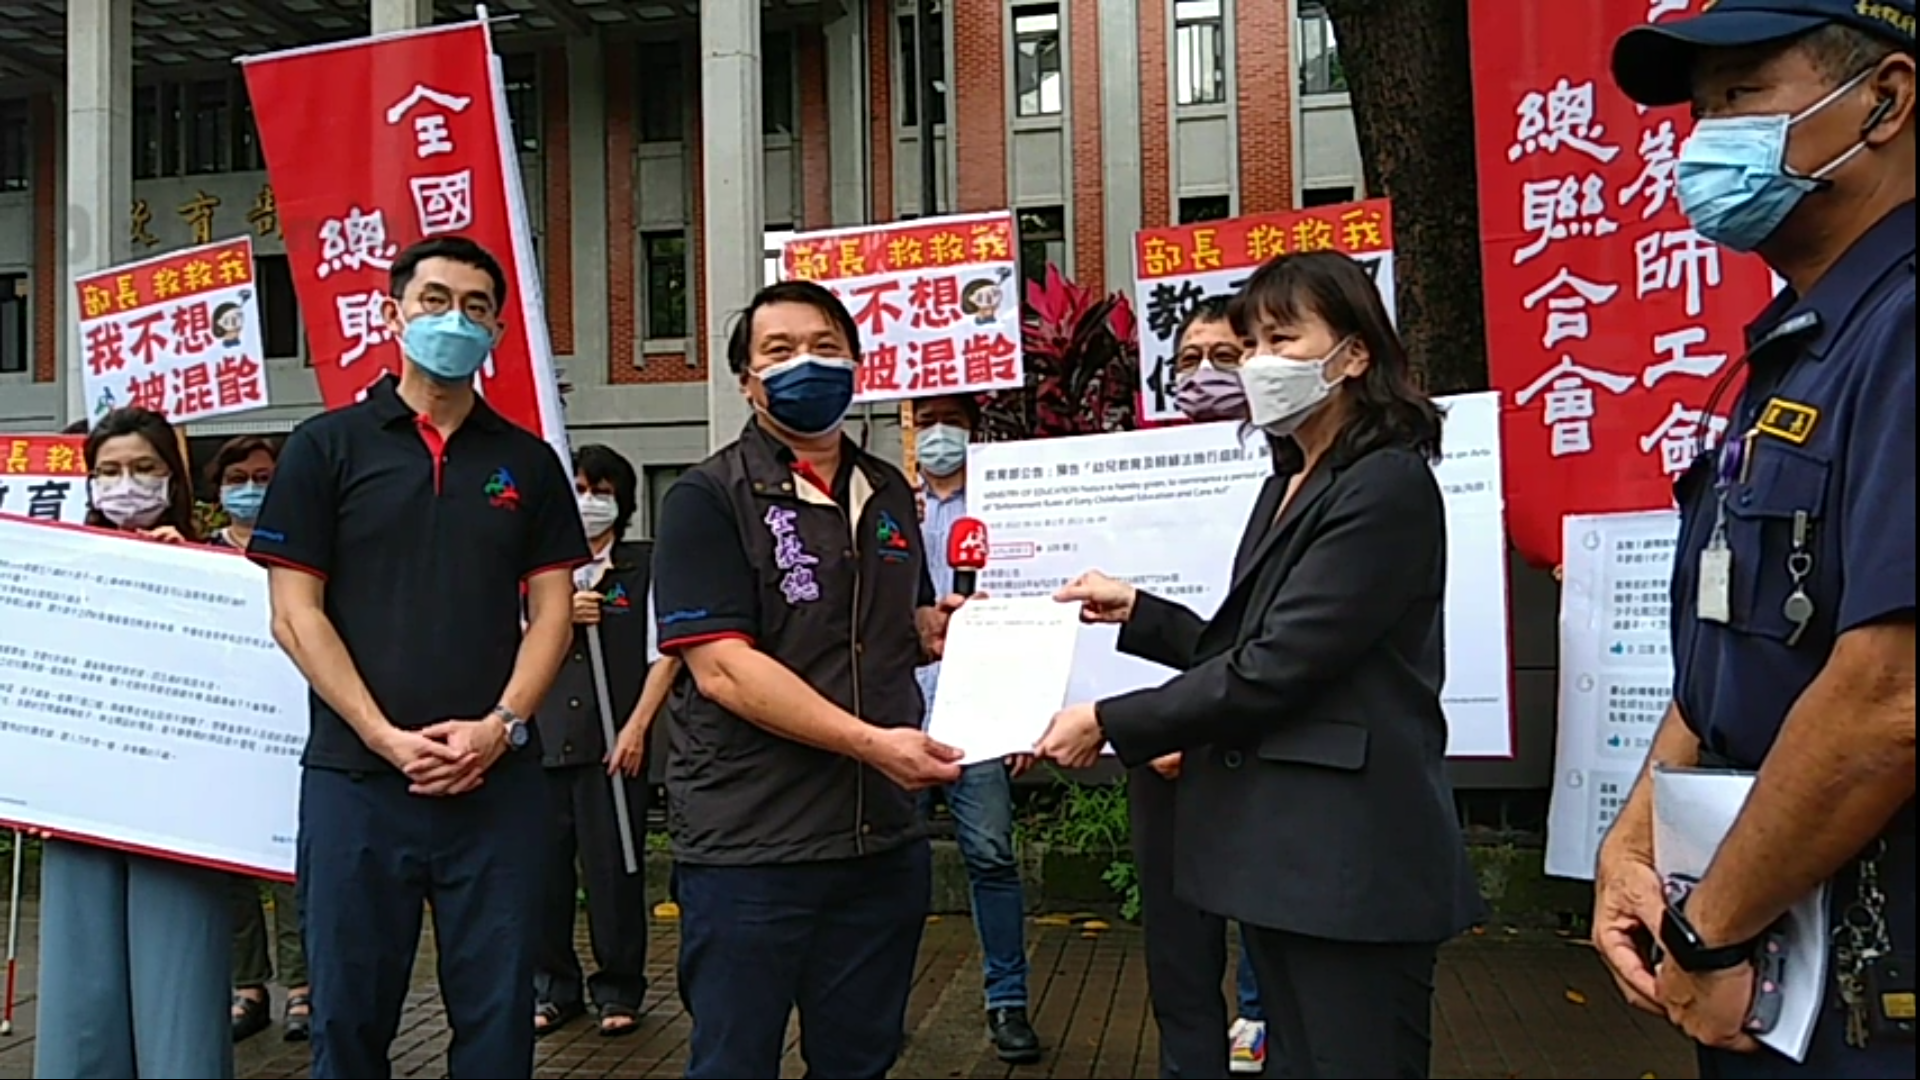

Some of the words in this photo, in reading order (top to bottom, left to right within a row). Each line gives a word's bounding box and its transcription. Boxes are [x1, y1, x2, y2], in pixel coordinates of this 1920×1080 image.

[792, 238, 865, 280] 部長
[888, 222, 1008, 267] 救救我
[1144, 228, 1223, 275] 部長
[1246, 209, 1383, 259] 救救我
[1507, 78, 1636, 457] 總聯合會
[83, 274, 139, 317] 部長
[152, 250, 248, 298] 救救我
[829, 276, 962, 335] 不想
[85, 301, 213, 376] 我不想
[126, 353, 261, 418] 被混齡
[0, 480, 71, 522] 育
